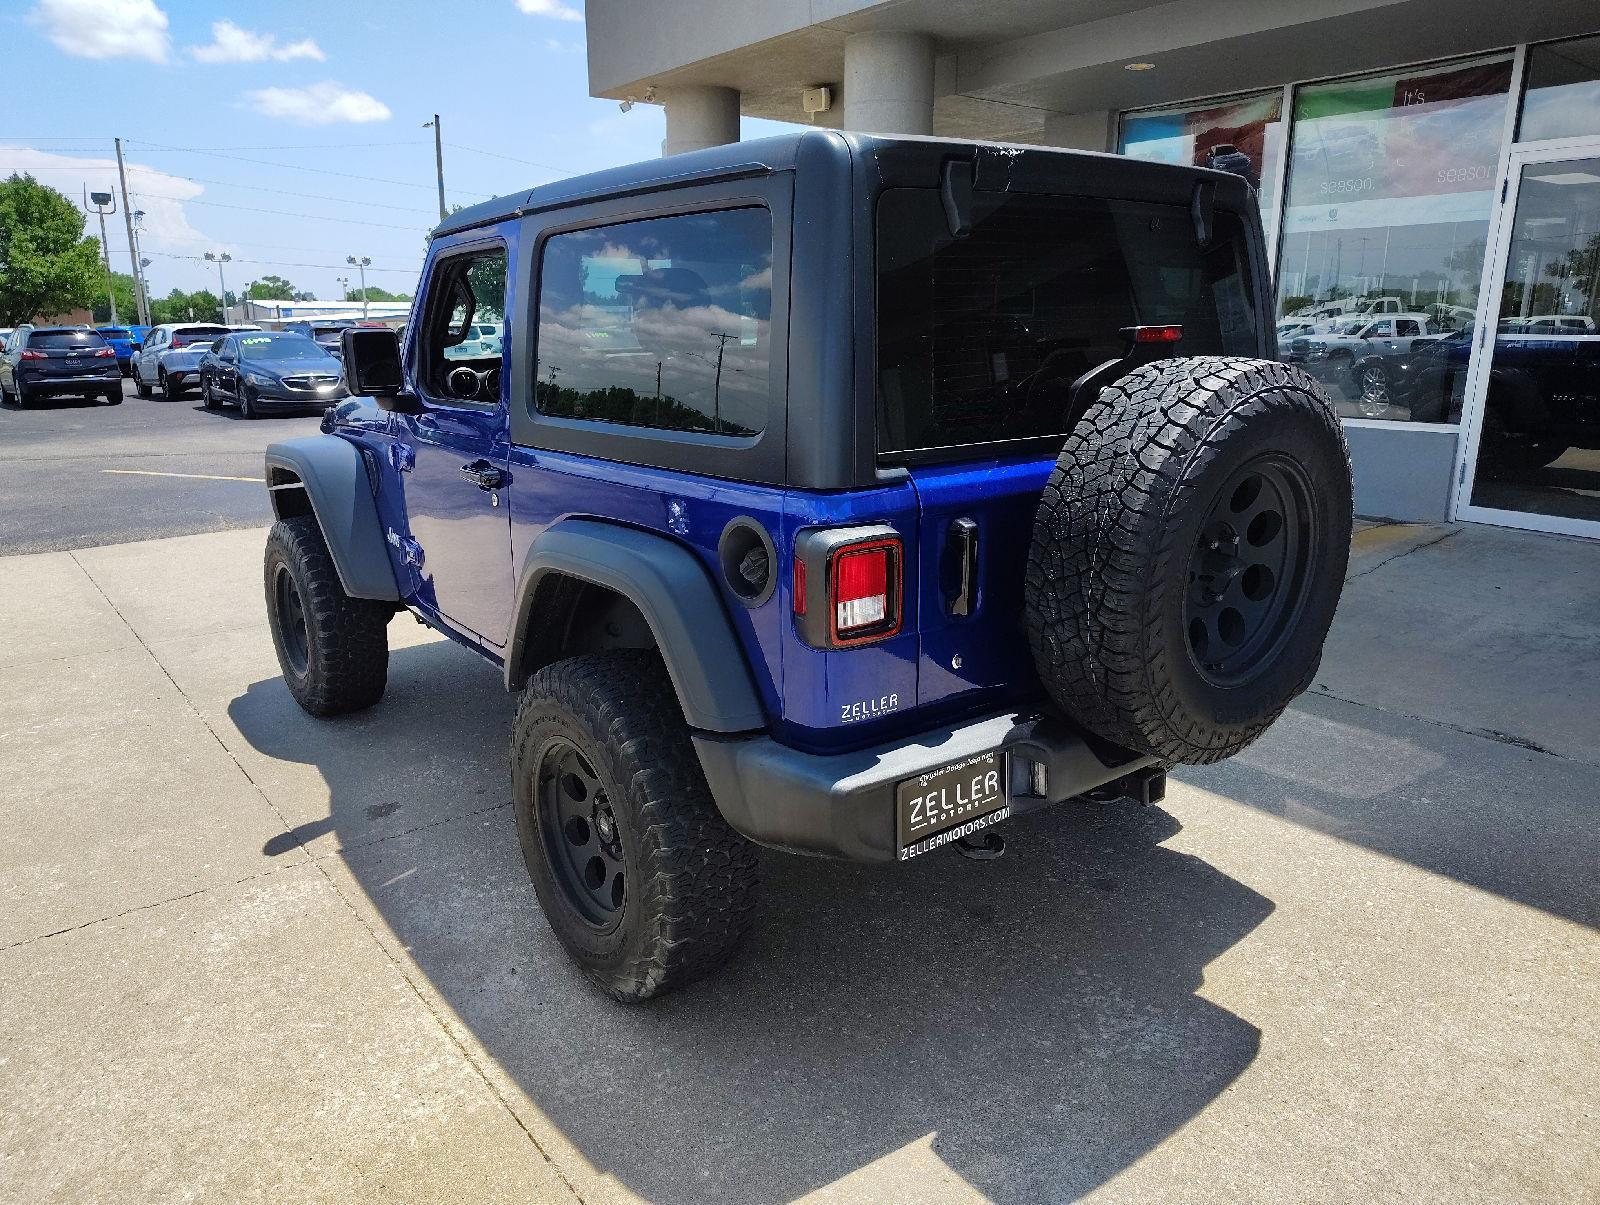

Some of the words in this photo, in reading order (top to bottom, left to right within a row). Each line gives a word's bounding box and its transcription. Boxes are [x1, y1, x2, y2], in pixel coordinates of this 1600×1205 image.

[1403, 88, 1425, 107] It's
[841, 693, 898, 719] ZELLER
[908, 770, 999, 825] ZELLER
[930, 802, 980, 825] MOTORS
[900, 807, 1010, 861] ZELLERMOTORS.COM
